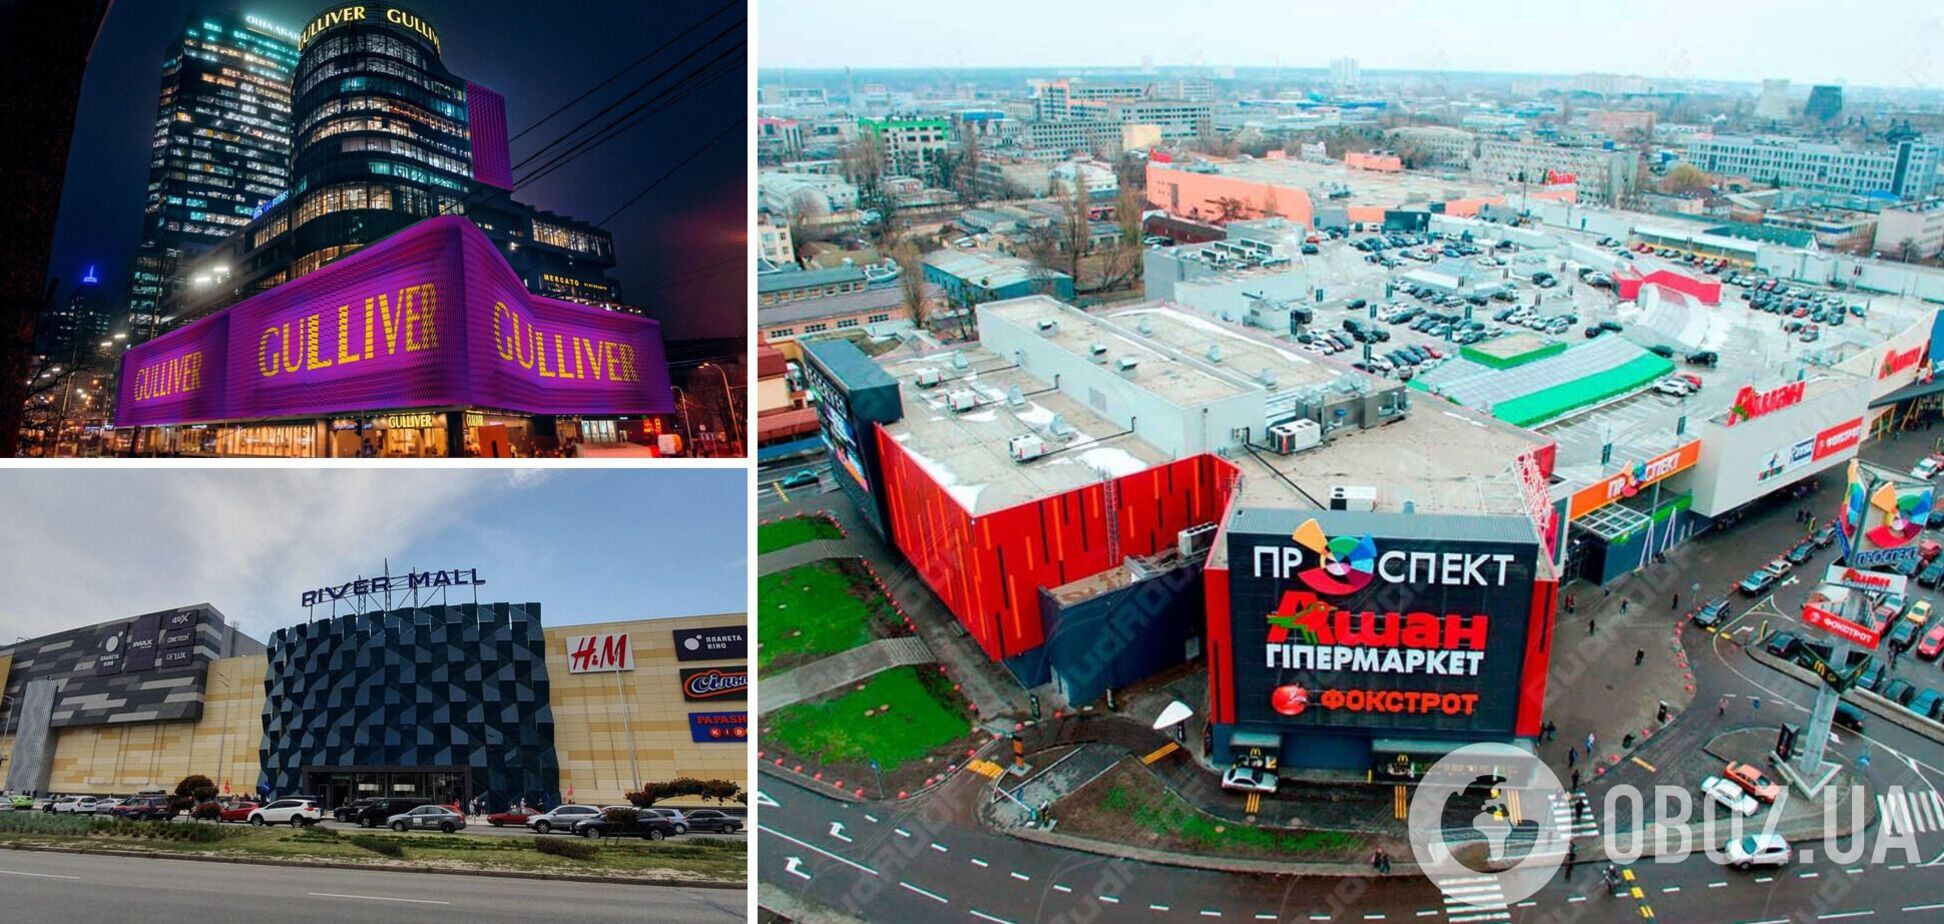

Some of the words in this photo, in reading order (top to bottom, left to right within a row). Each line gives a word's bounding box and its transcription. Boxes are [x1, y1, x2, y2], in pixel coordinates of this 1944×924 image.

[543, 273, 579, 287] MERCATO
[258, 283, 438, 378] GULLIVER
[494, 301, 640, 383] GULLIVER
[134, 351, 203, 401] GULLIVER
[388, 414, 432, 429] GULLIVER
[302, 576, 390, 607] RIVER
[408, 568, 486, 588] MALL
[1266, 590, 1489, 651] Ашан
[1823, 616, 1873, 643] ФОКСТРОТ
[133, 639, 153, 648] IMAX
[572, 633, 628, 671] H&M
[706, 634, 742, 643] ПЛАНЕТА
[1266, 644, 1485, 676] ГІПЕРМАРКЕТ
[1320, 688, 1479, 716] ФОКСТРОТ
